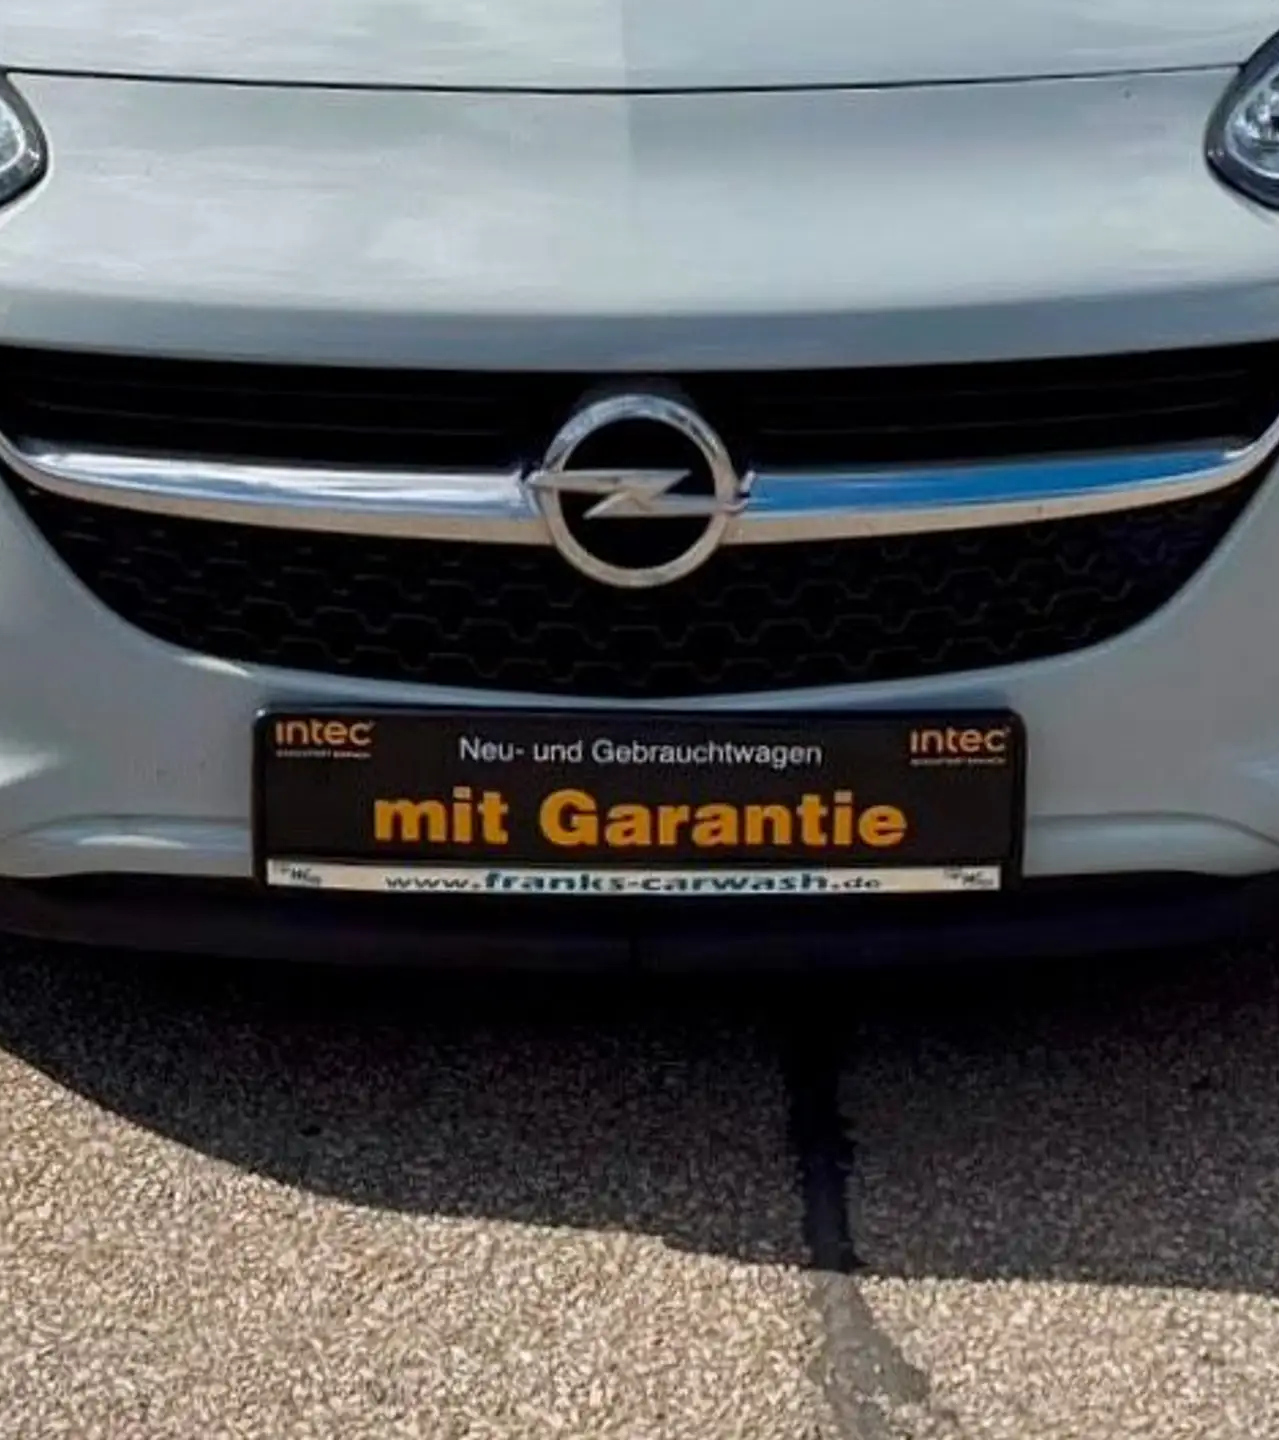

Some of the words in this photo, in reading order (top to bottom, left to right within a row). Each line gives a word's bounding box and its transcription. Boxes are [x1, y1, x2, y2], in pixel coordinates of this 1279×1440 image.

[276, 719, 371, 745] intec
[910, 727, 1006, 753] intec
[459, 737, 525, 761] Neu-
[533, 739, 583, 762] und
[591, 738, 822, 770] Gebrauchtwagen
[374, 786, 508, 844] mit
[539, 789, 908, 847] Garantie
[384, 870, 882, 891] www.franks-carwash.de
